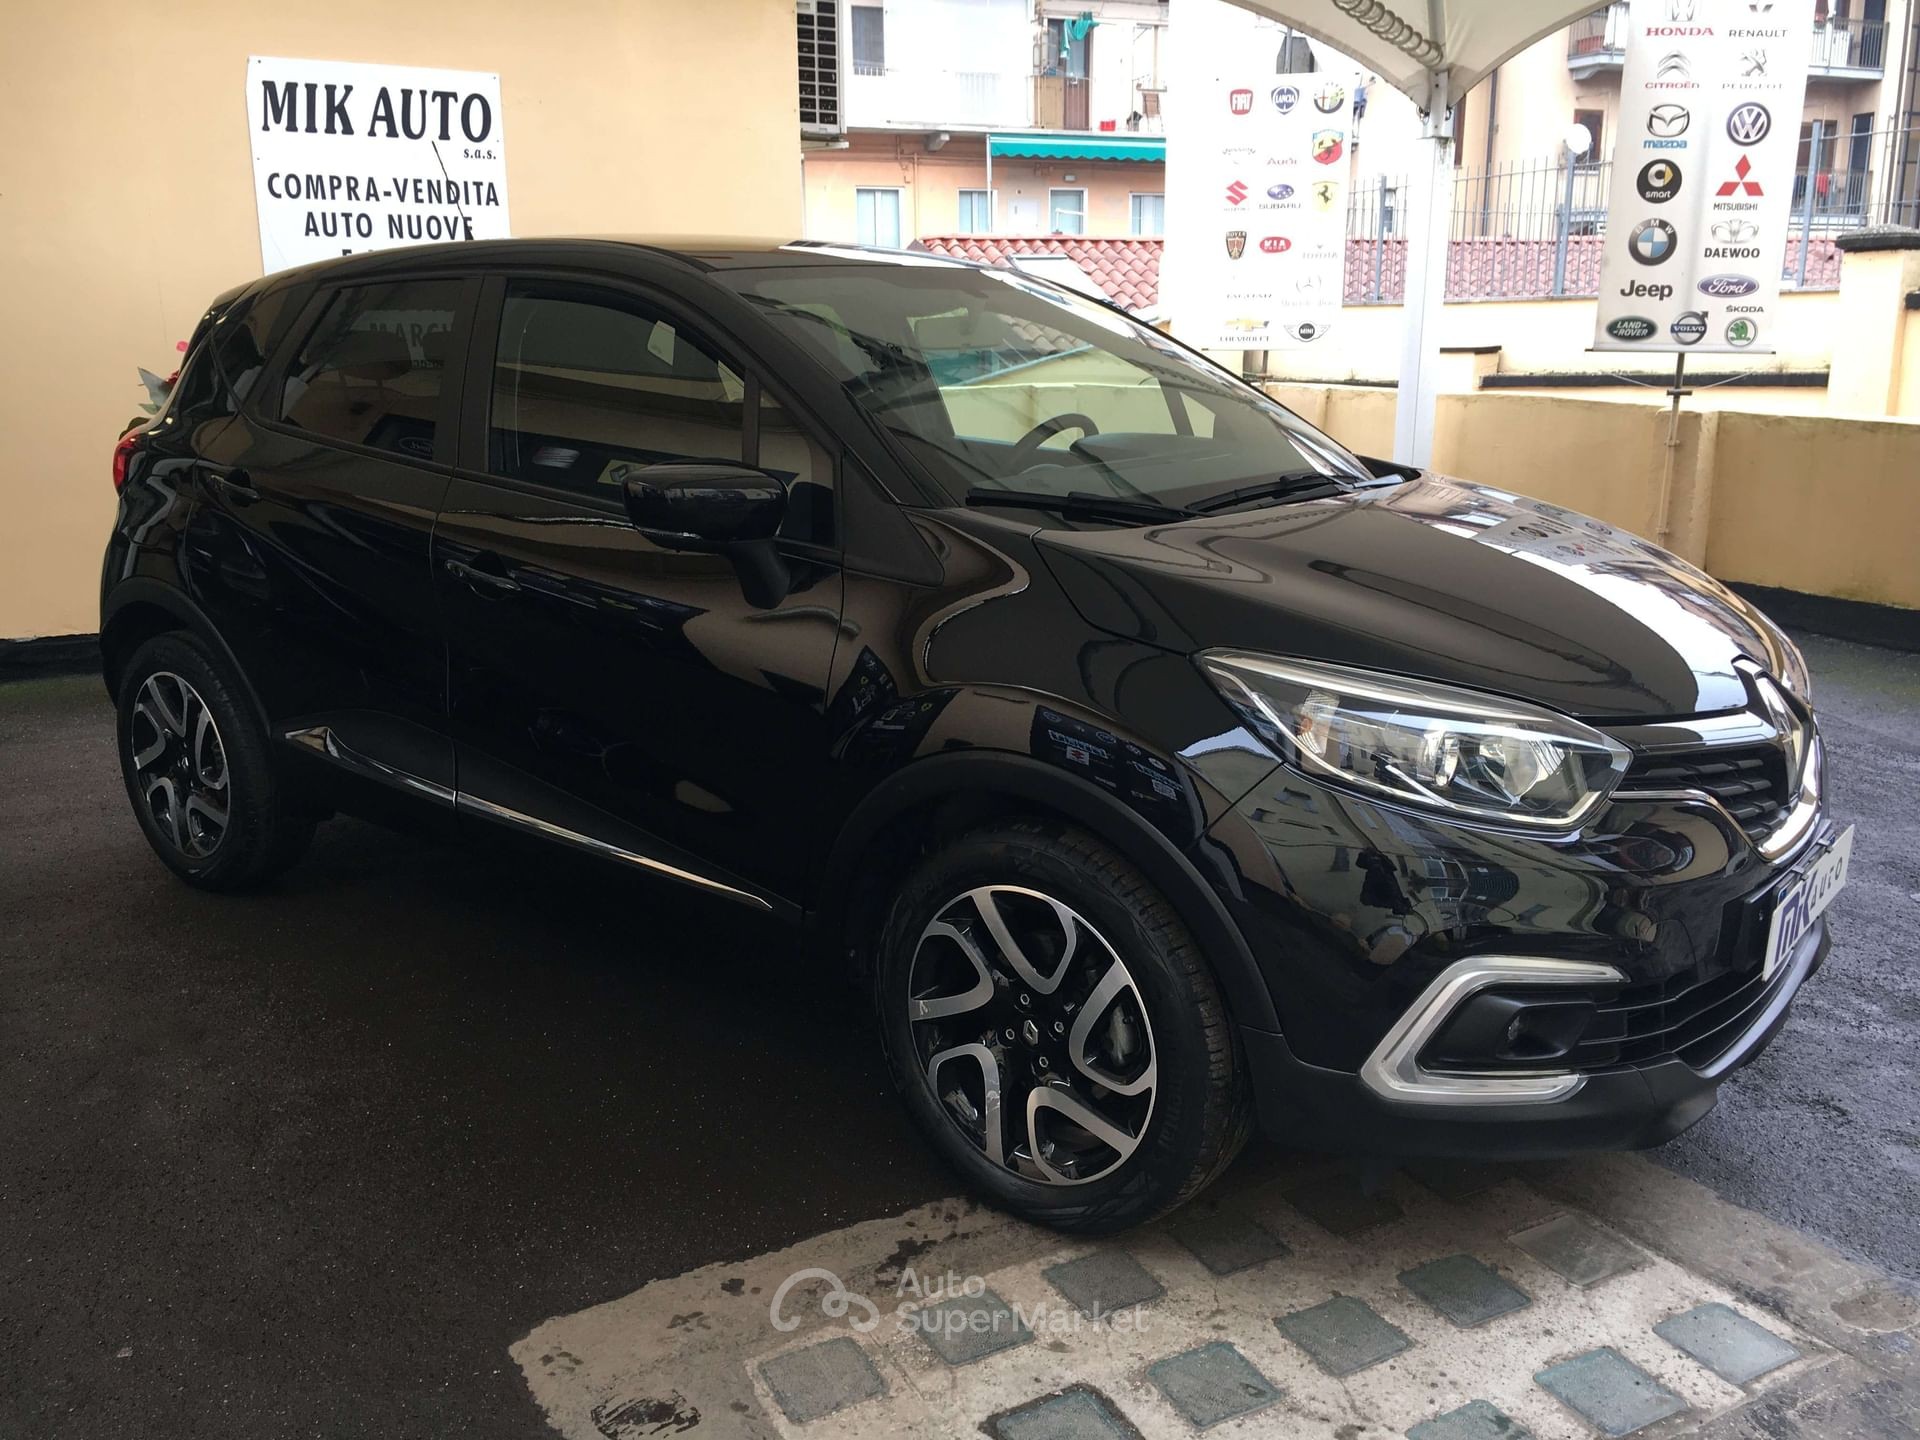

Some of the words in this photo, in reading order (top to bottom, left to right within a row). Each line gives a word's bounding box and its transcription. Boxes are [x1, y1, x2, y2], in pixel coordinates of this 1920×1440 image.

[1646, 27, 1714, 37] HONDA
[1728, 29, 1788, 38] RENAULT
[261, 79, 354, 136] MIK
[367, 86, 492, 143] AUTO
[463, 148, 497, 160] s.a.s.
[267, 172, 500, 207] COMPRA-VENDITA
[1645, 190, 1672, 199] smart
[1713, 202, 1758, 211] MITSUBISHI
[304, 211, 373, 238] AUTO
[1263, 239, 1287, 250] KIA
[1704, 247, 1760, 258] DAEWOO
[1620, 280, 1673, 301] Jeep
[1707, 277, 1747, 294] Ford
[1616, 321, 1641, 329] LAND
[1617, 329, 1648, 337] ROVER
